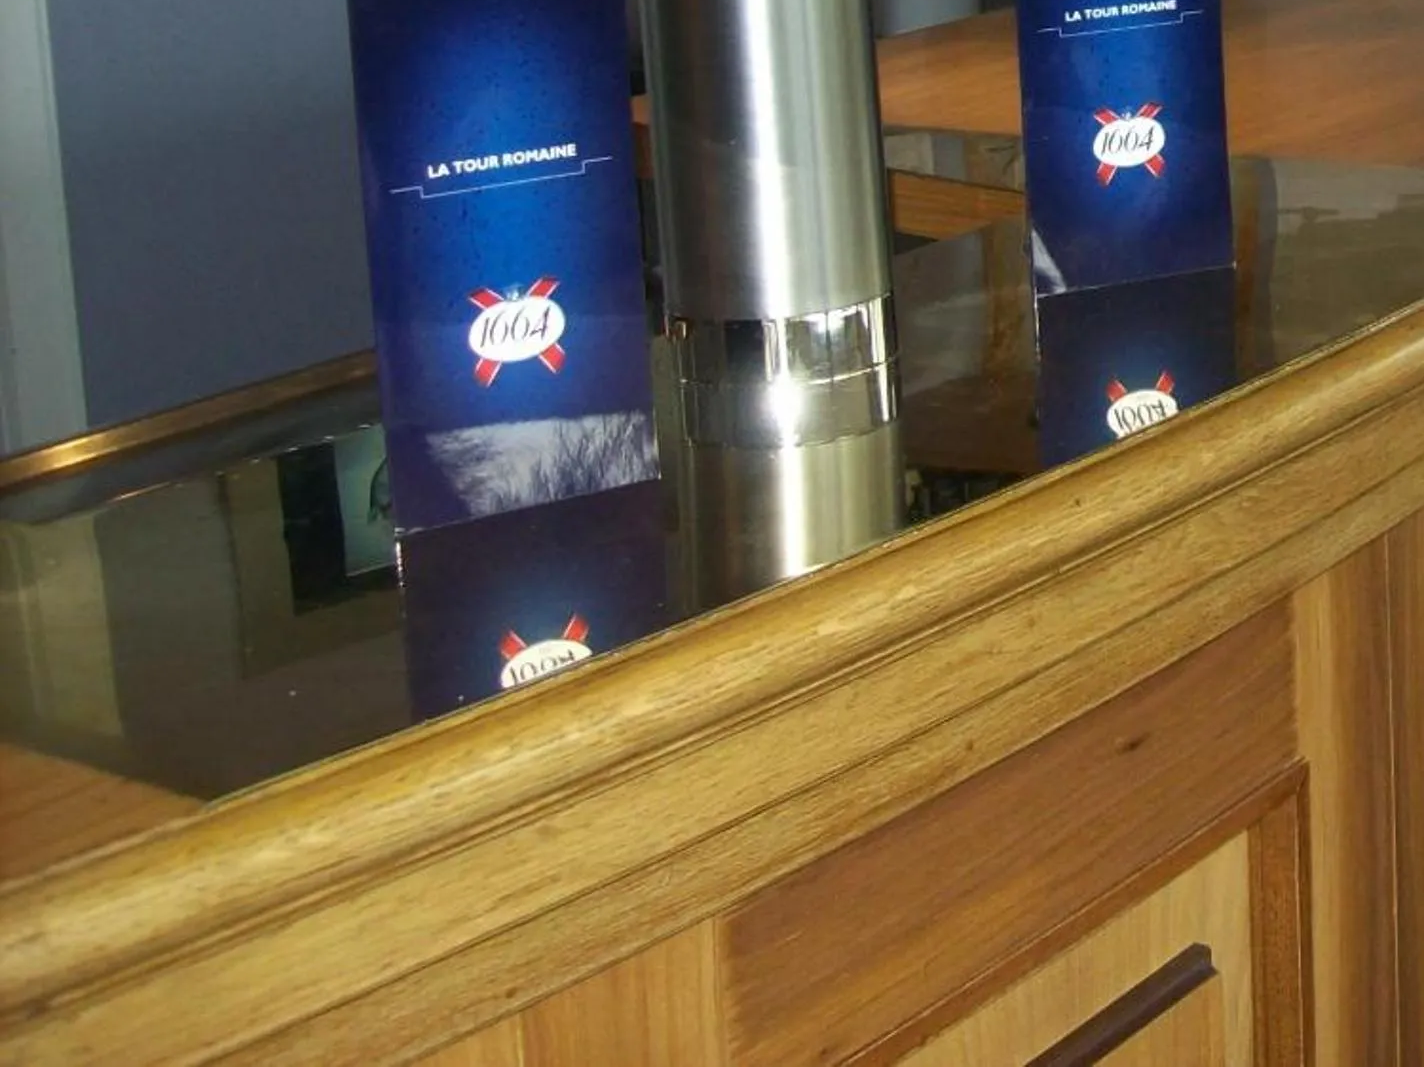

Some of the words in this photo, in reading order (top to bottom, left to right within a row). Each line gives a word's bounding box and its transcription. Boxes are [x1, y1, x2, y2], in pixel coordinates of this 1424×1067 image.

[1065, 10, 1082, 23] LA
[1084, 6, 1119, 19] TOUR
[1101, 125, 1155, 156] 1664
[427, 164, 450, 179] LA
[452, 155, 500, 174] TOUR
[502, 143, 577, 166] ROMAINE
[480, 306, 550, 348] 1664
